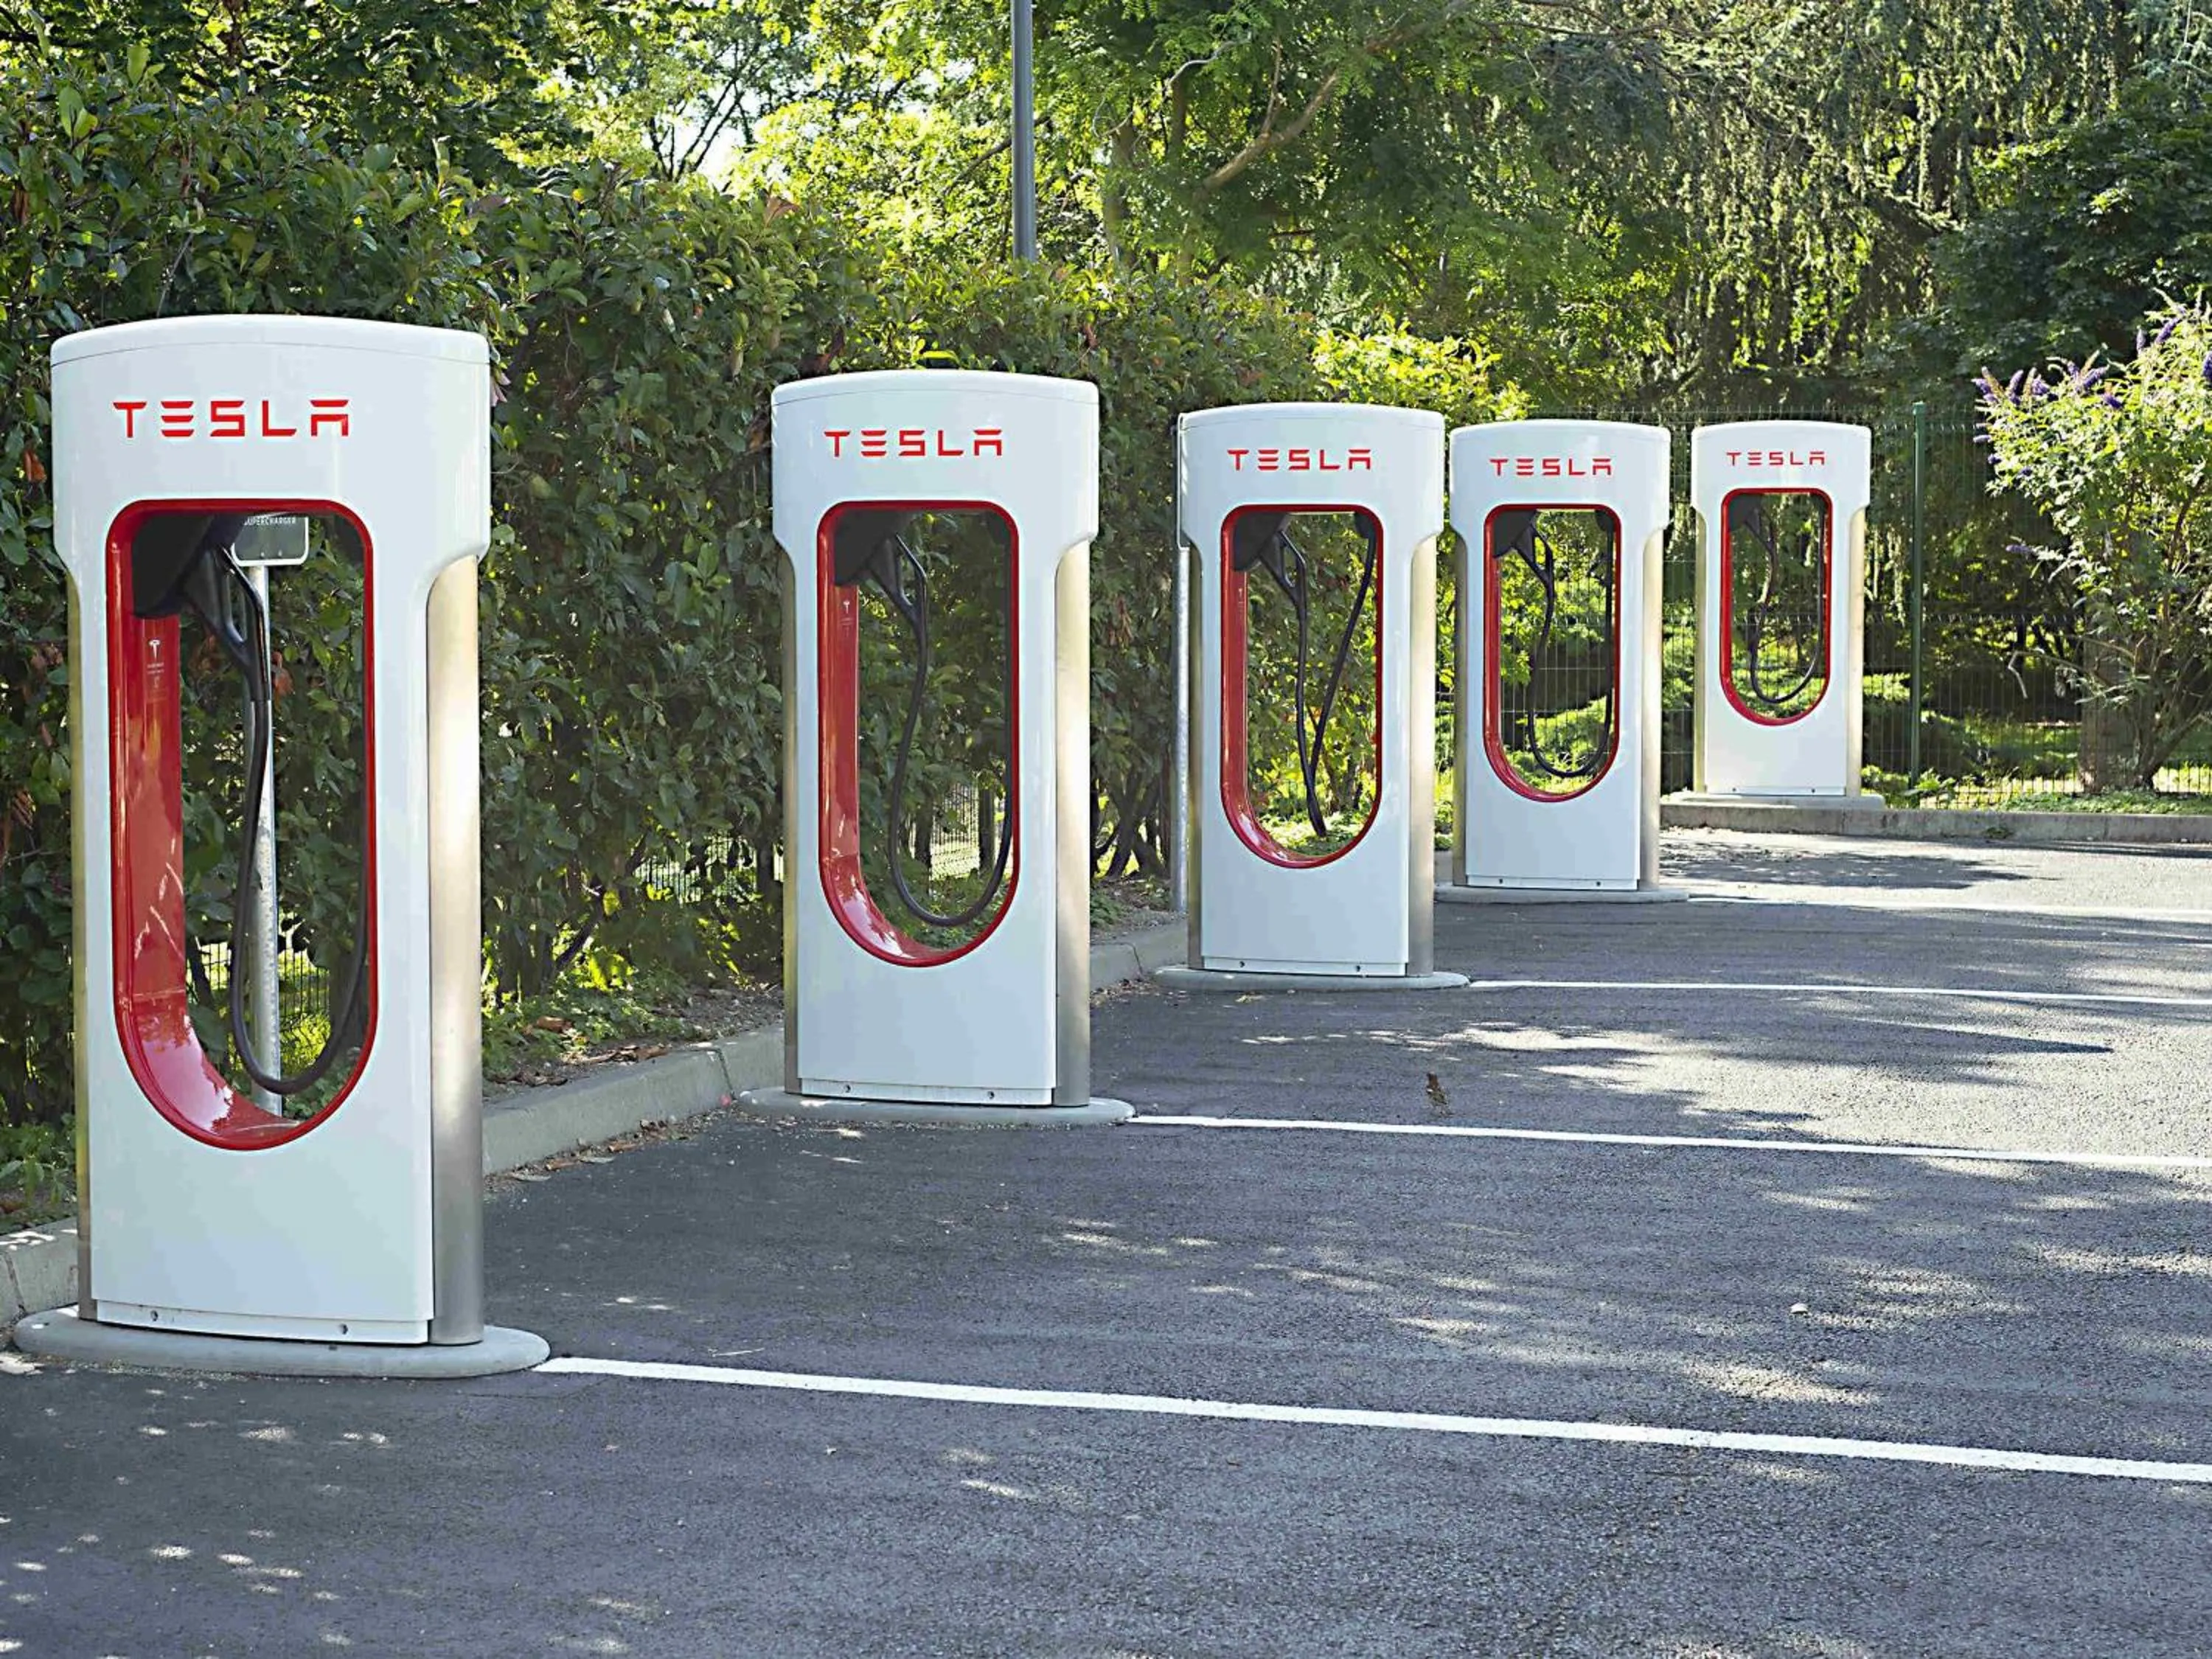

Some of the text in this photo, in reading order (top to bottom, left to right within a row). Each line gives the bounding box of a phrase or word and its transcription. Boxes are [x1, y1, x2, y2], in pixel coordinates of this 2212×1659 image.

[113, 399, 349, 438] TESLA
[824, 429, 1003, 457] TESLA
[1227, 448, 1371, 471] TESLA
[1489, 458, 1613, 476] TESLA
[1726, 451, 1826, 466] TESLA
